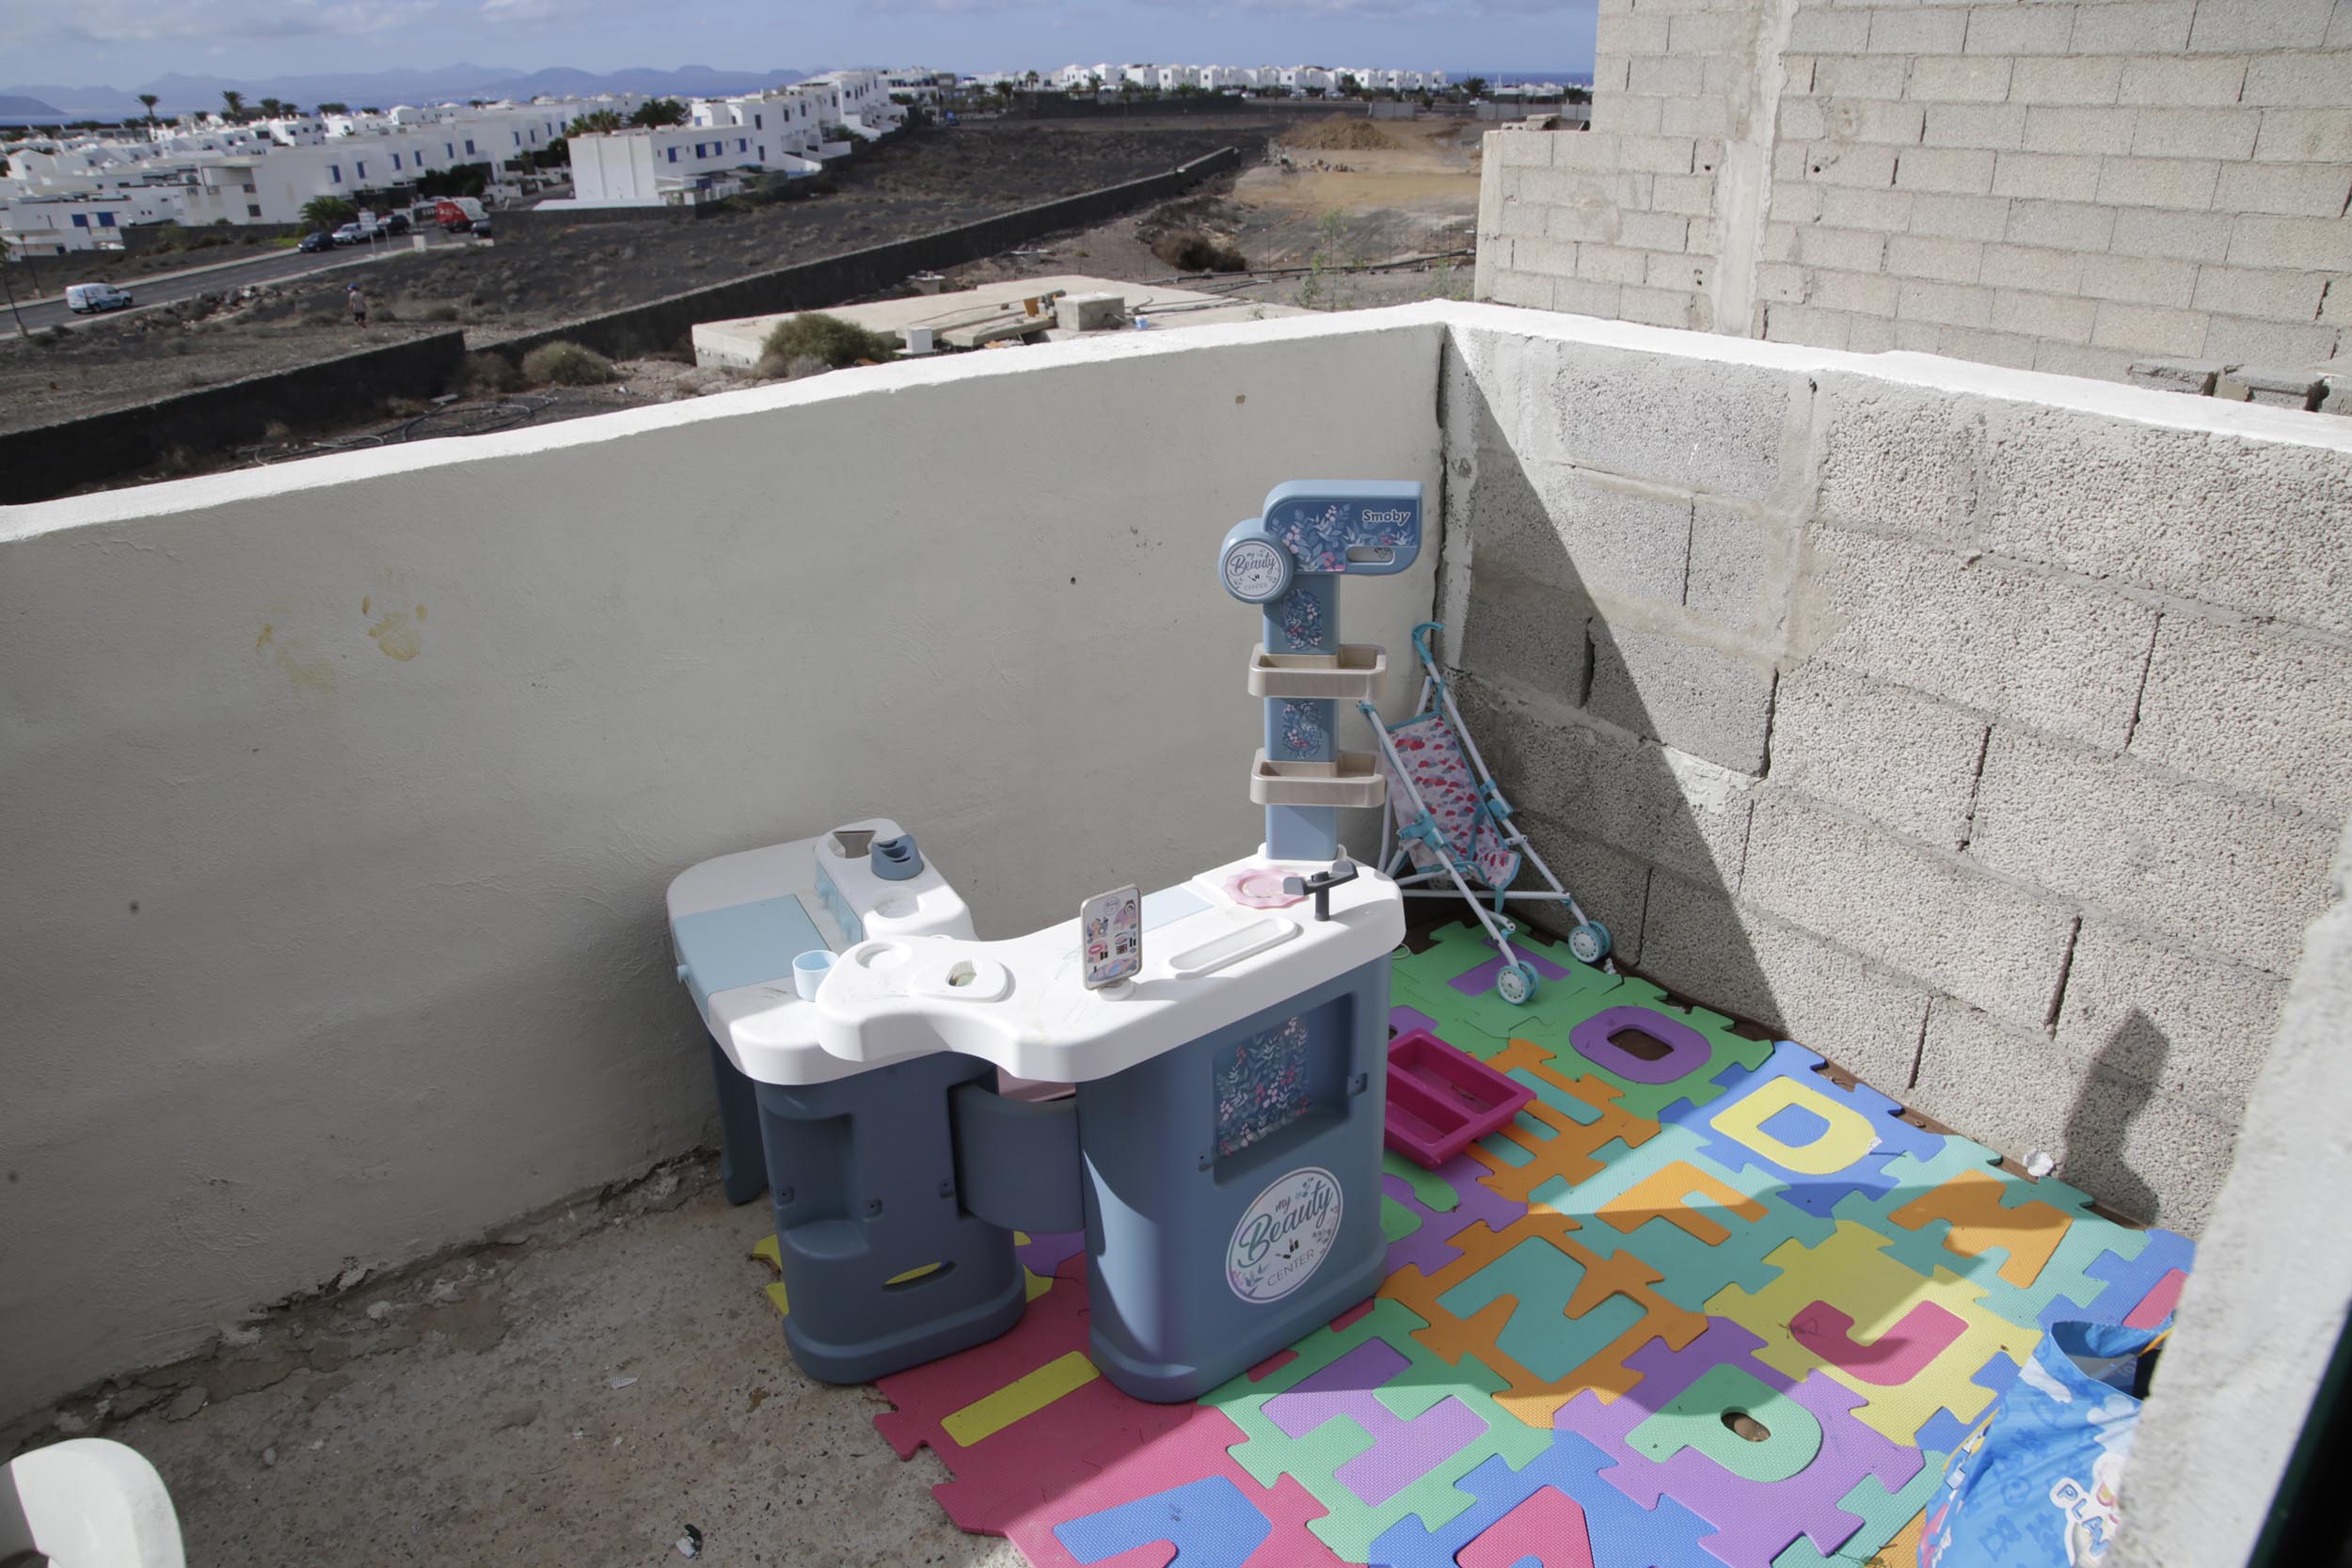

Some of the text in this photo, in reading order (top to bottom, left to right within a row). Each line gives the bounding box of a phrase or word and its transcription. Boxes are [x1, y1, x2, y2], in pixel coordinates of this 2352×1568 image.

[1362, 509, 1411, 527] Smoby
[1230, 552, 1276, 577] Beauty
[1709, 1075, 1877, 1174] D
[1237, 1180, 1334, 1269] Beauty
[1275, 1196, 1293, 1214] my
[1595, 1160, 1770, 1246] F
[1266, 1248, 1315, 1287] CENTER
[1790, 1300, 1970, 1386] J
[1260, 1336, 1490, 1506] H
[1624, 1362, 1822, 1482] P
